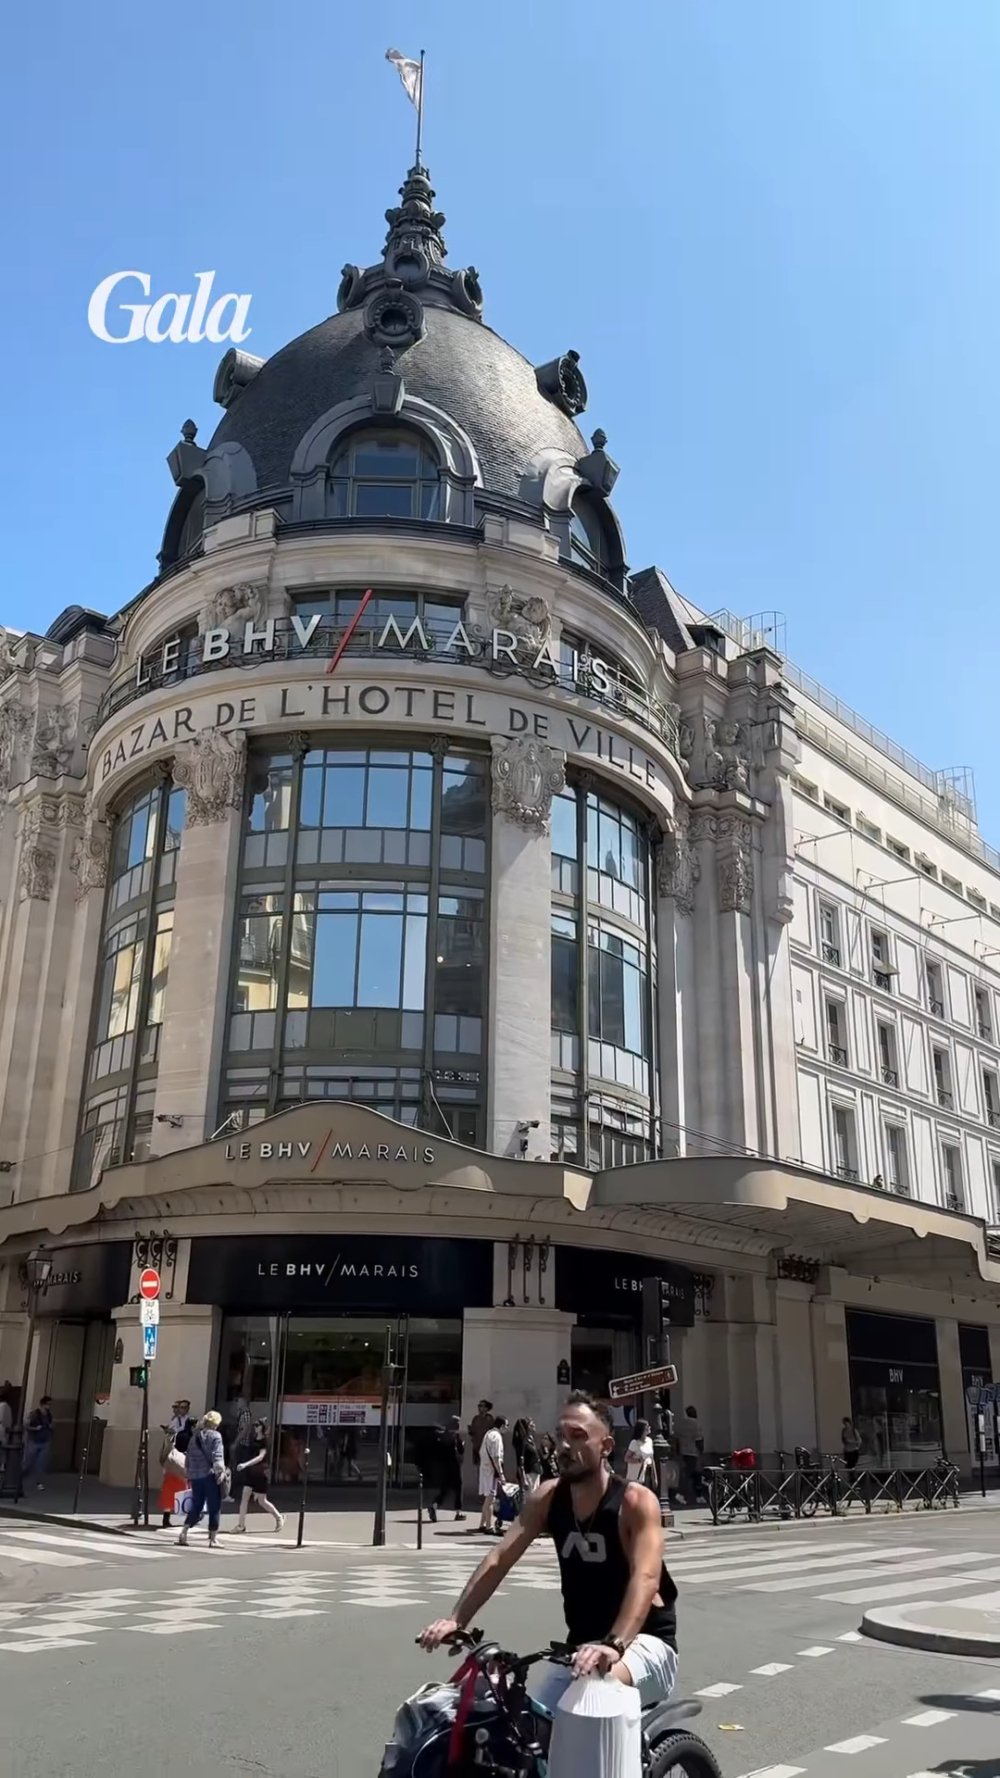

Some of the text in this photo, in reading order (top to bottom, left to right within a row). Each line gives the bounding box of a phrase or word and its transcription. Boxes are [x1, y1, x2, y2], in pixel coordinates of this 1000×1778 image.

[136, 639, 181, 688] LE
[202, 614, 323, 663] BHV
[377, 613, 611, 693] MARAIS
[102, 684, 656, 791] BAZAR DE L'HOTEL DE VILLE
[224, 1142, 251, 1161] LE
[260, 1141, 313, 1159] BHV
[332, 1142, 436, 1164] MARAIS
[258, 1263, 279, 1276] LE
[285, 1263, 326, 1276] BHV
[340, 1264, 419, 1278] MARAIS
[614, 1277, 628, 1290] LE
[889, 1368, 904, 1383] BHV
